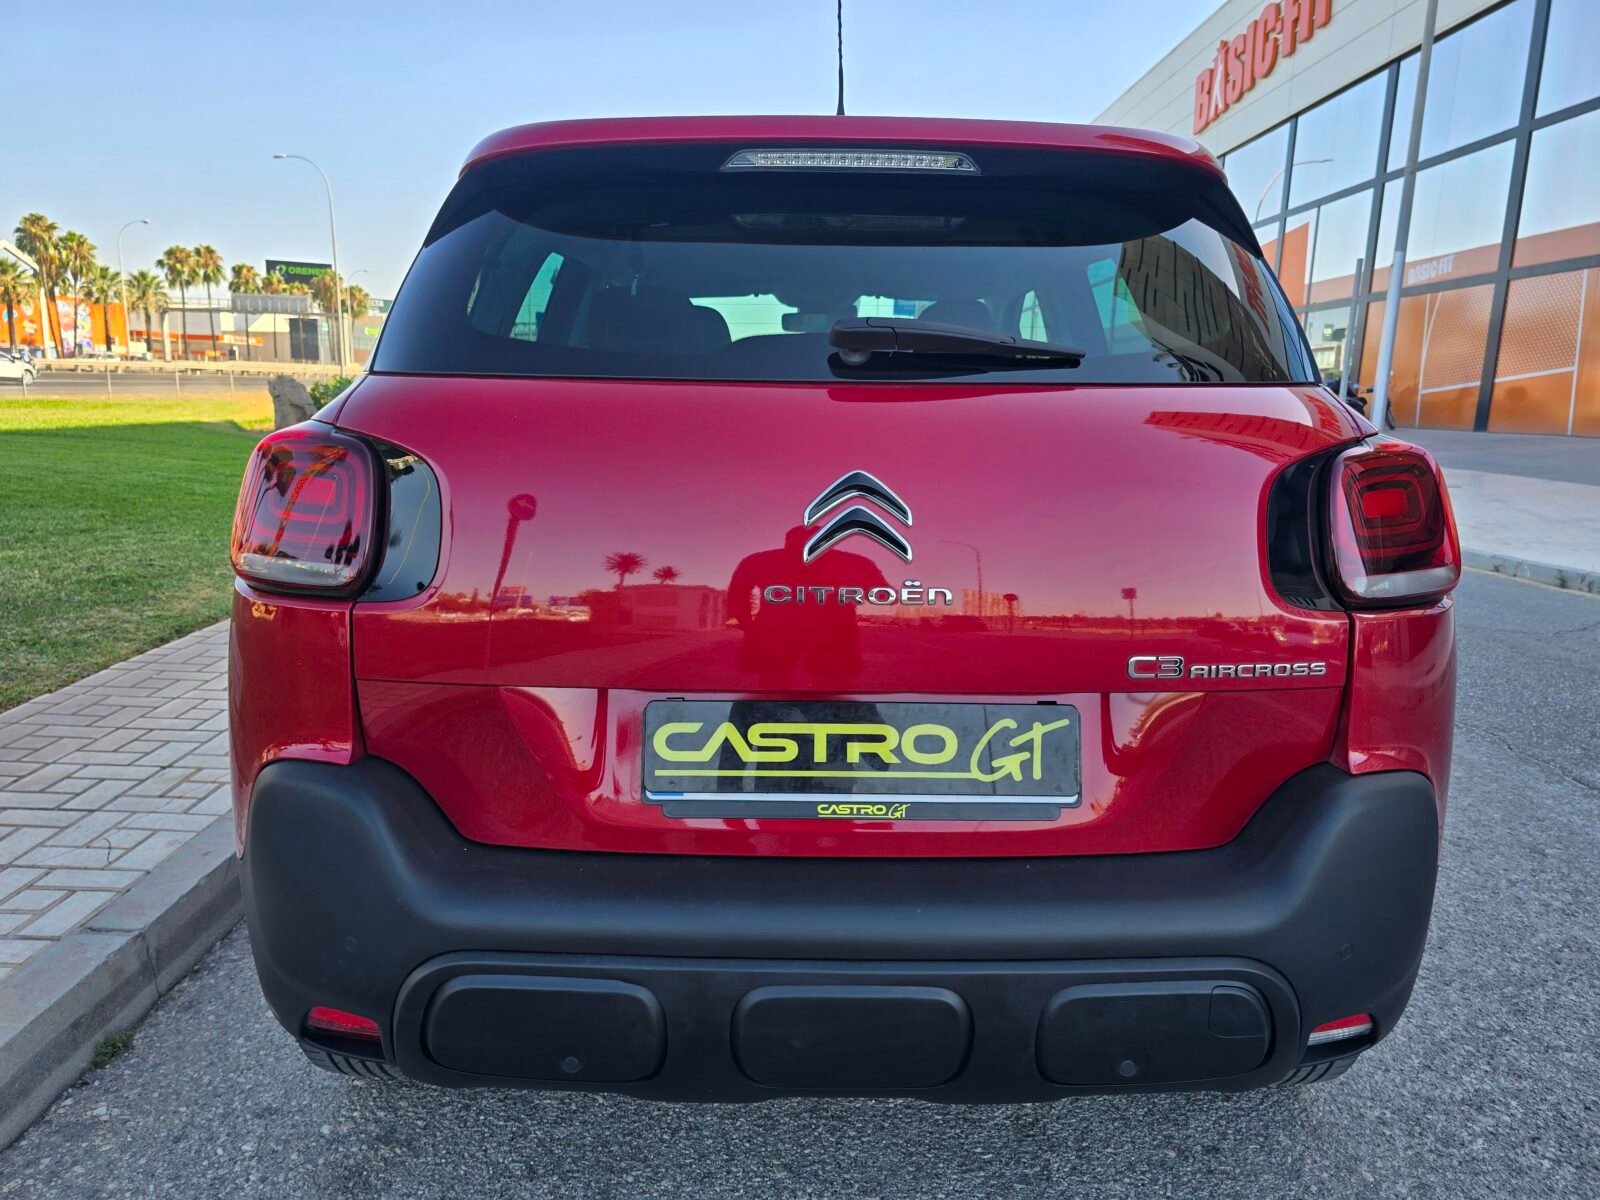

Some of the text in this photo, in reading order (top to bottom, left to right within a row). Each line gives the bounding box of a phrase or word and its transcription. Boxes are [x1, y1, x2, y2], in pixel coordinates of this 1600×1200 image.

[1128, 655, 1327, 679] C3 AIRCROSS
[653, 718, 1070, 782] CASTRO GT
[817, 803, 911, 818] CASTRO GT
